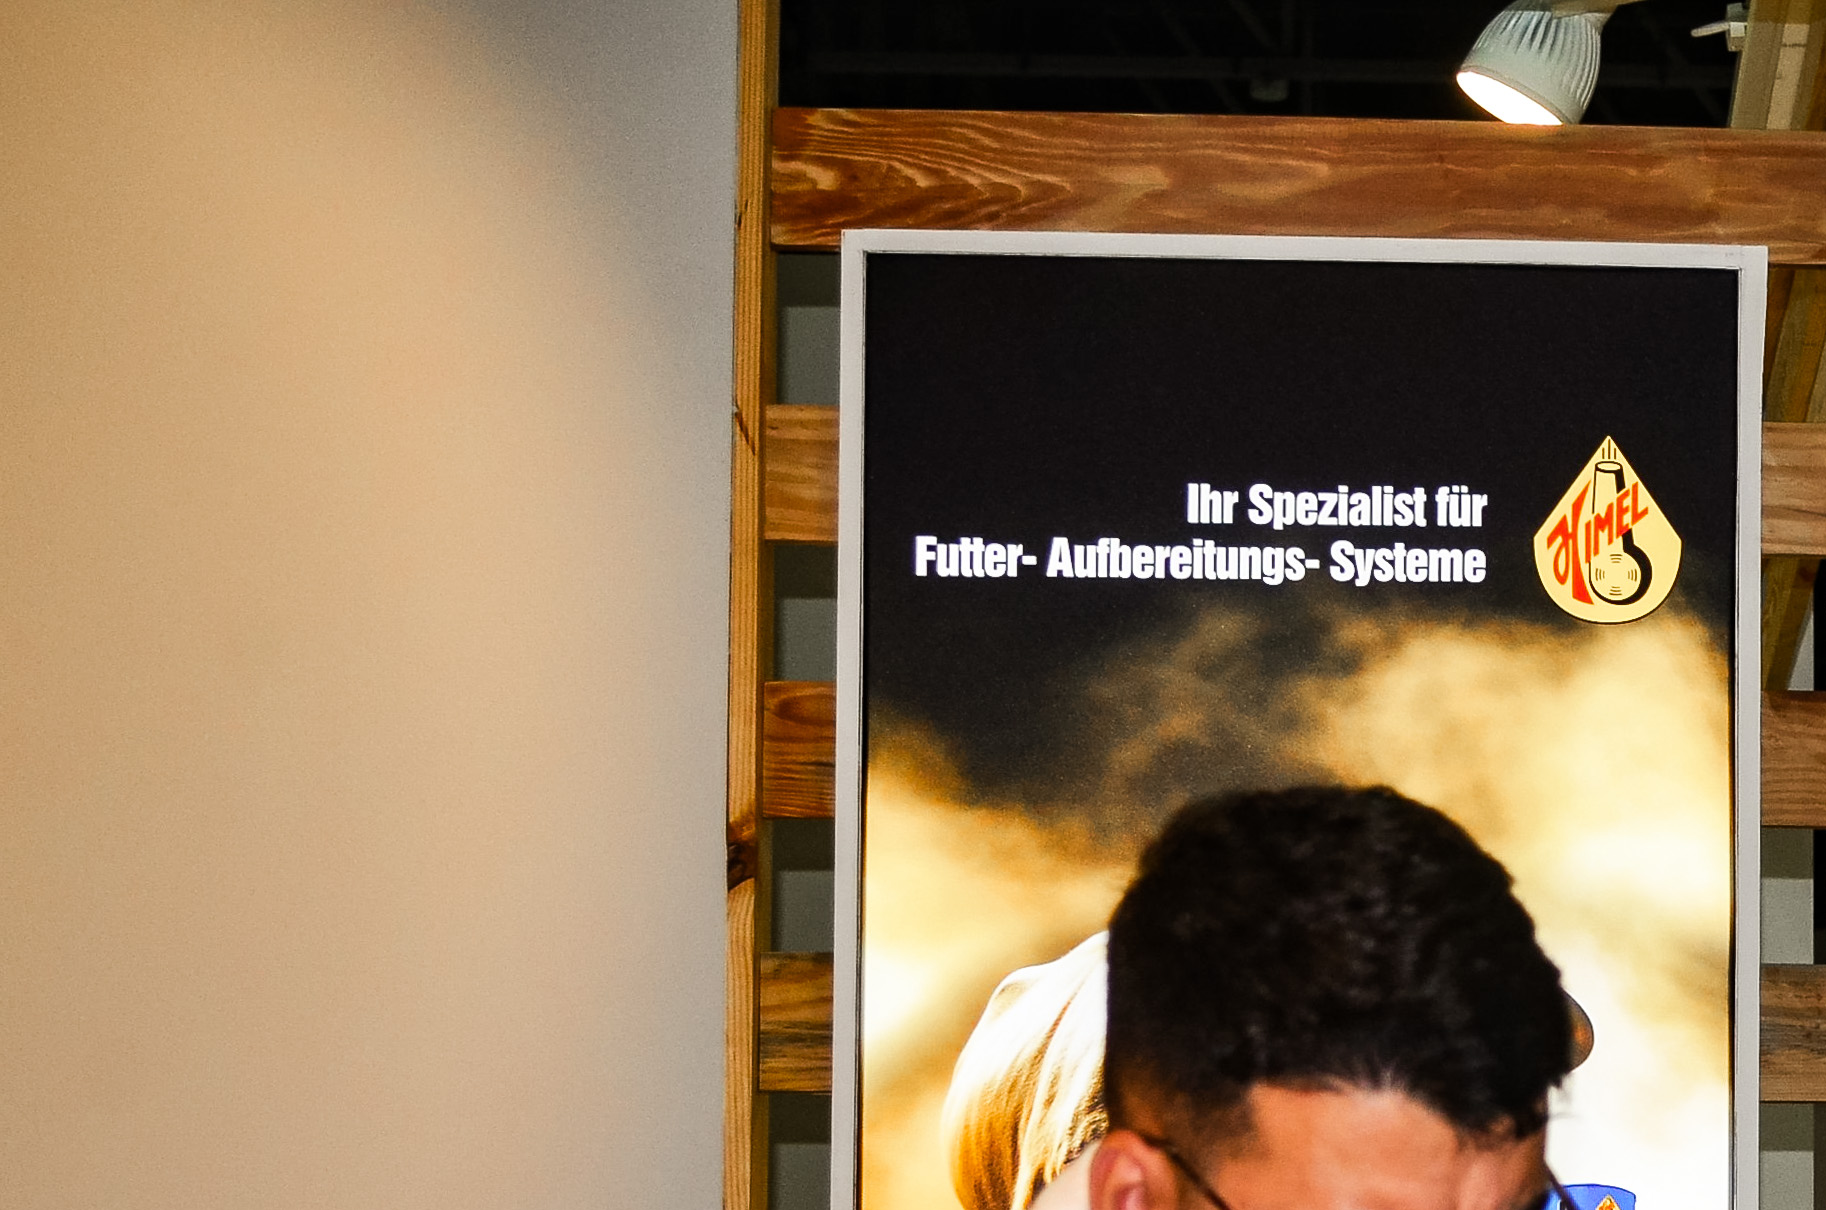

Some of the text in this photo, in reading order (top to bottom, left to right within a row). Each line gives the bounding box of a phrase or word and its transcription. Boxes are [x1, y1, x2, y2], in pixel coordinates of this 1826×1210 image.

[1187, 483, 1487, 530] Ihr Spezialist für
[914, 536, 1486, 585] Futter- Aufbereitungs- Systeme
[1546, 478, 1649, 606] HIMEL
